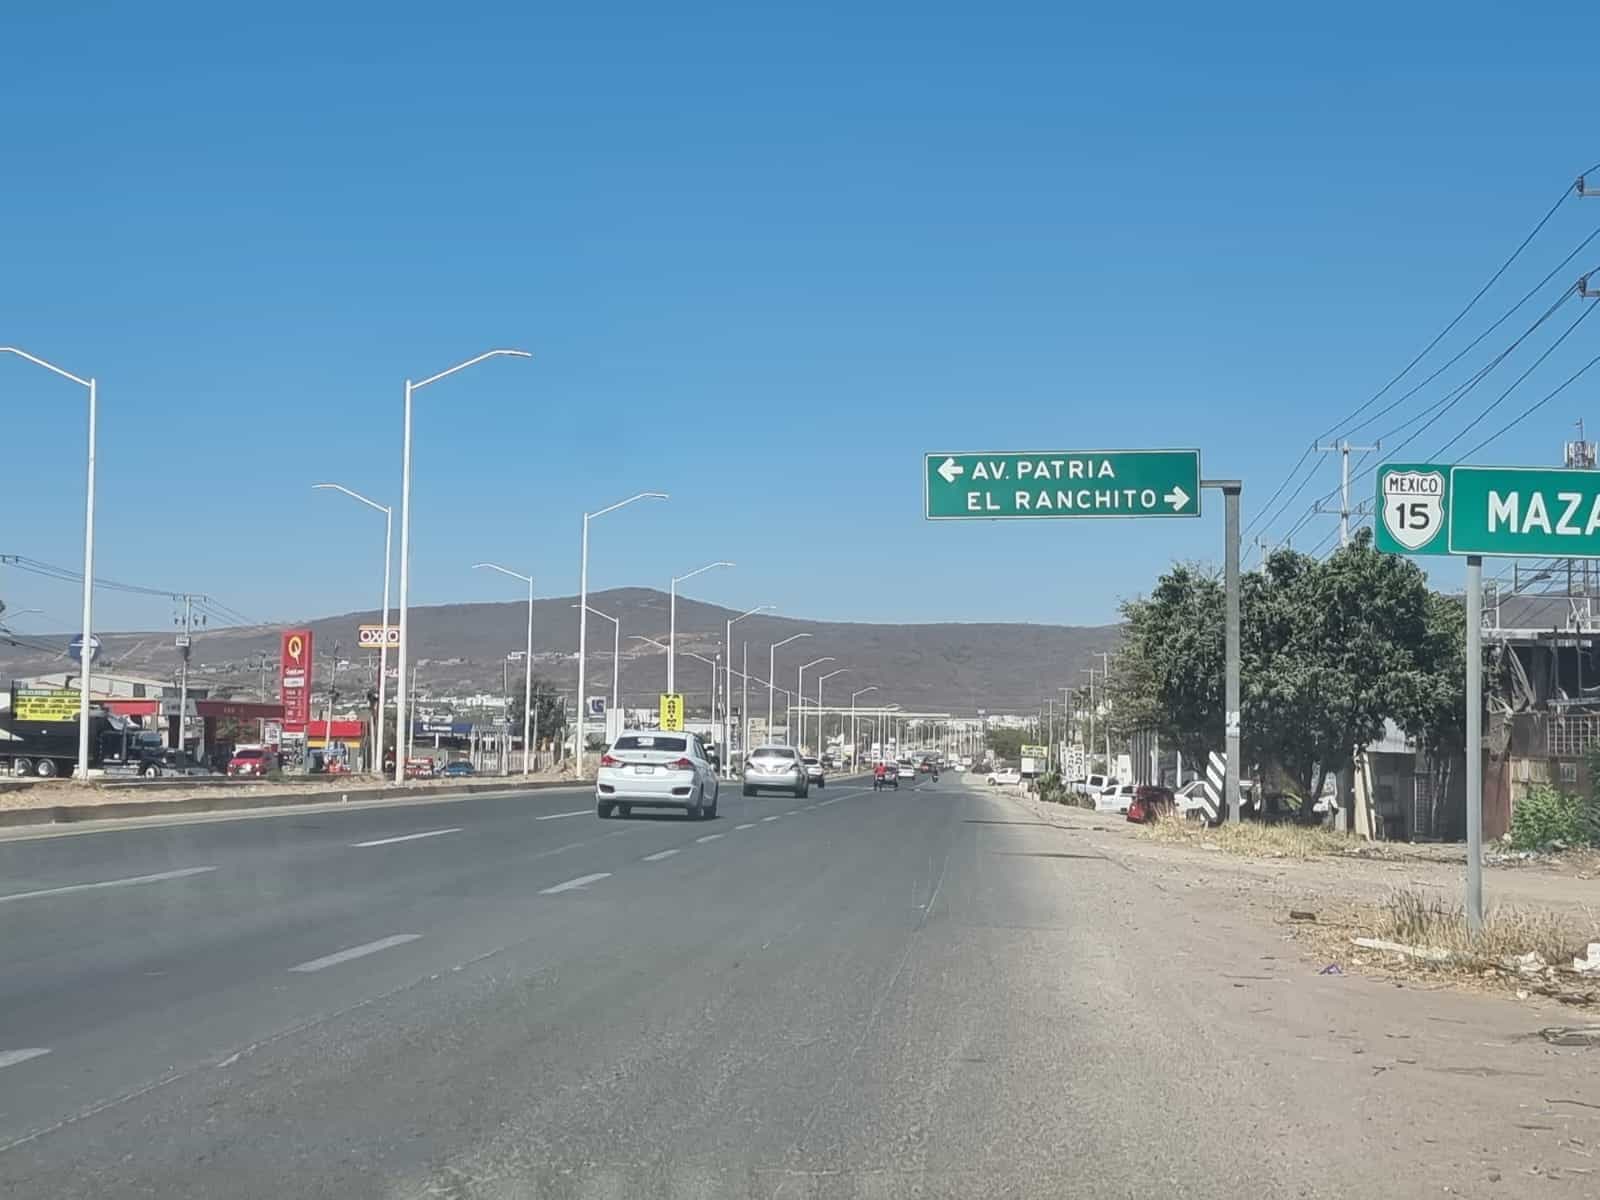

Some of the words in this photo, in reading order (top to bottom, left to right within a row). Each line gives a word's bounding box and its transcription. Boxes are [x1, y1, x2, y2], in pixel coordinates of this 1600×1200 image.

[971, 461, 1010, 480] AV.
[1016, 459, 1116, 479] PATRIA
[1389, 477, 1438, 493] MEXICO
[967, 491, 1001, 511] EL
[1015, 489, 1157, 510] RANCHITO
[1395, 502, 1430, 530] 15
